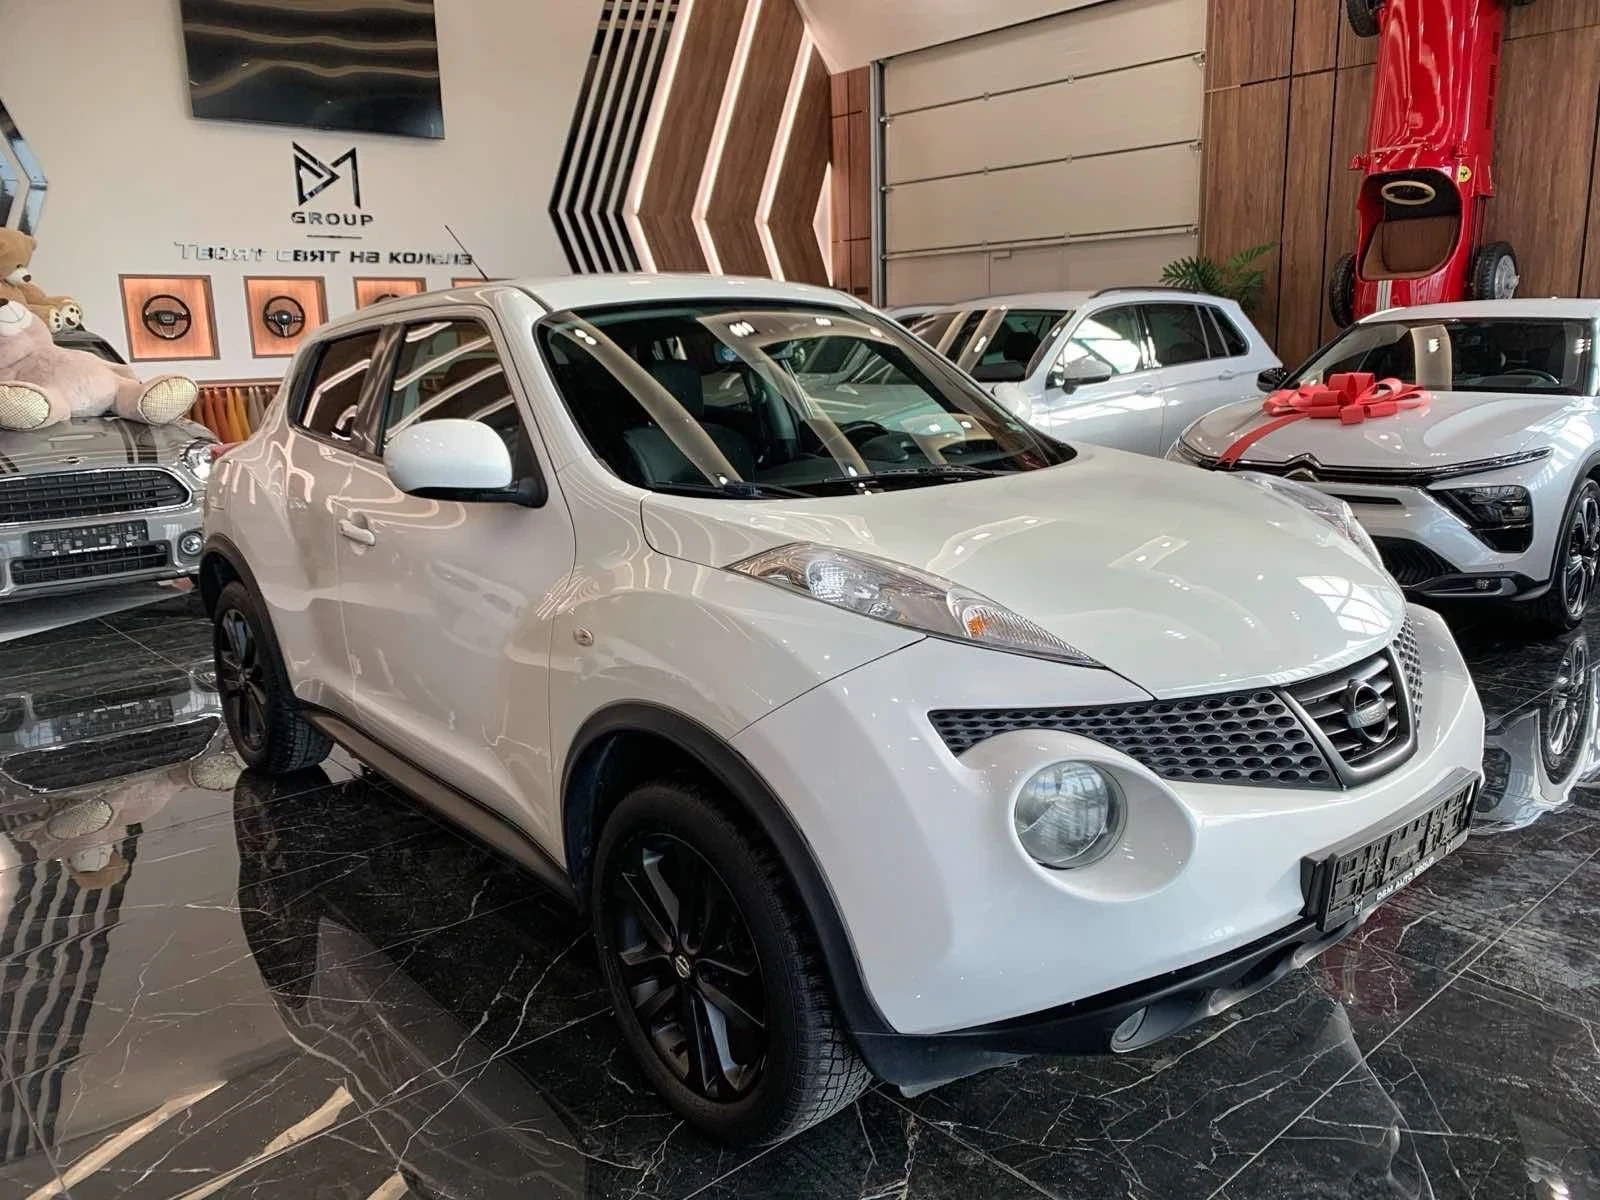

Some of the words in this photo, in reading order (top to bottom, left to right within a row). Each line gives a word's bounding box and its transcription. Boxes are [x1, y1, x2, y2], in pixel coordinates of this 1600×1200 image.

[291, 211, 374, 227] GROUP
[350, 251, 380, 263] на
[1395, 872, 1413, 889] AUTO
